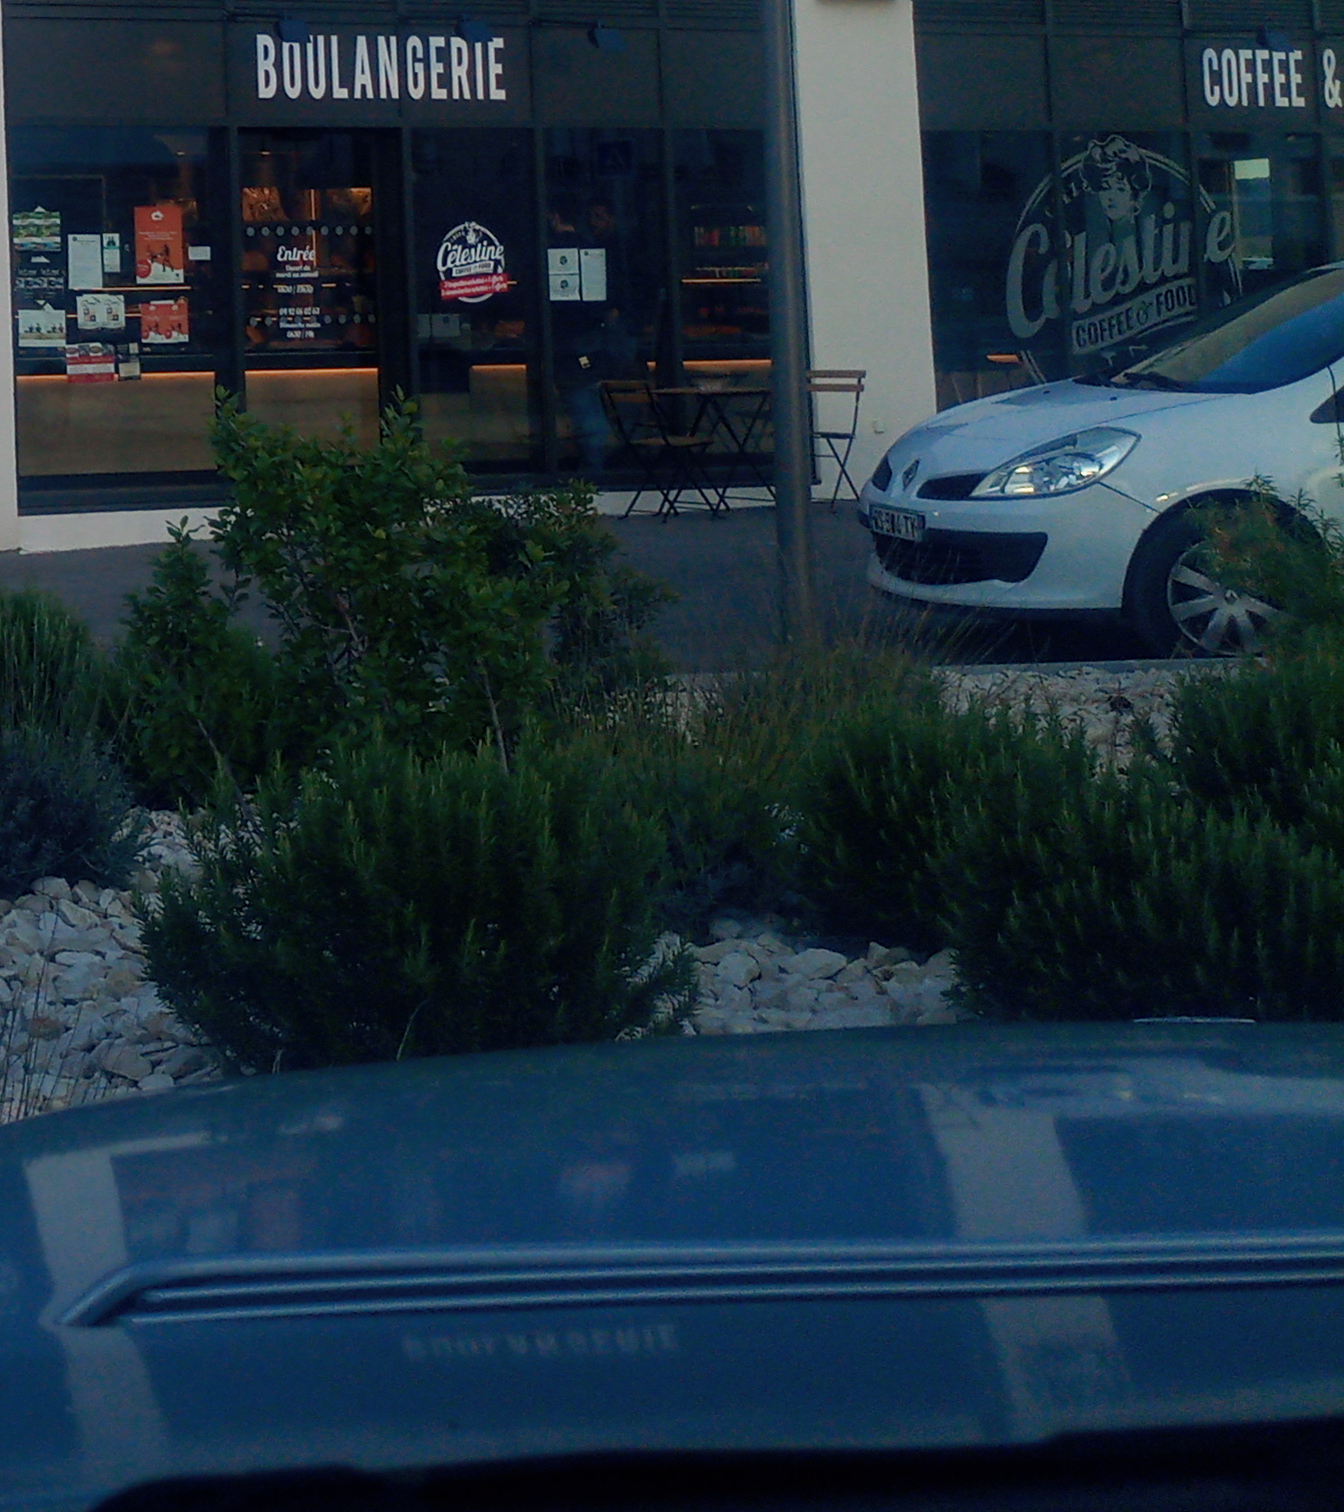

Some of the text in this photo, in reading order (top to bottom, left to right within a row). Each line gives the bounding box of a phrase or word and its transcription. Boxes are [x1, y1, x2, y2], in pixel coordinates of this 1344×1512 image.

[256, 34, 506, 100] BOULANGERIE
[1202, 48, 1343, 109] COFFEE &
[277, 245, 316, 262] Entrée
[1006, 202, 1236, 338] Clestie
